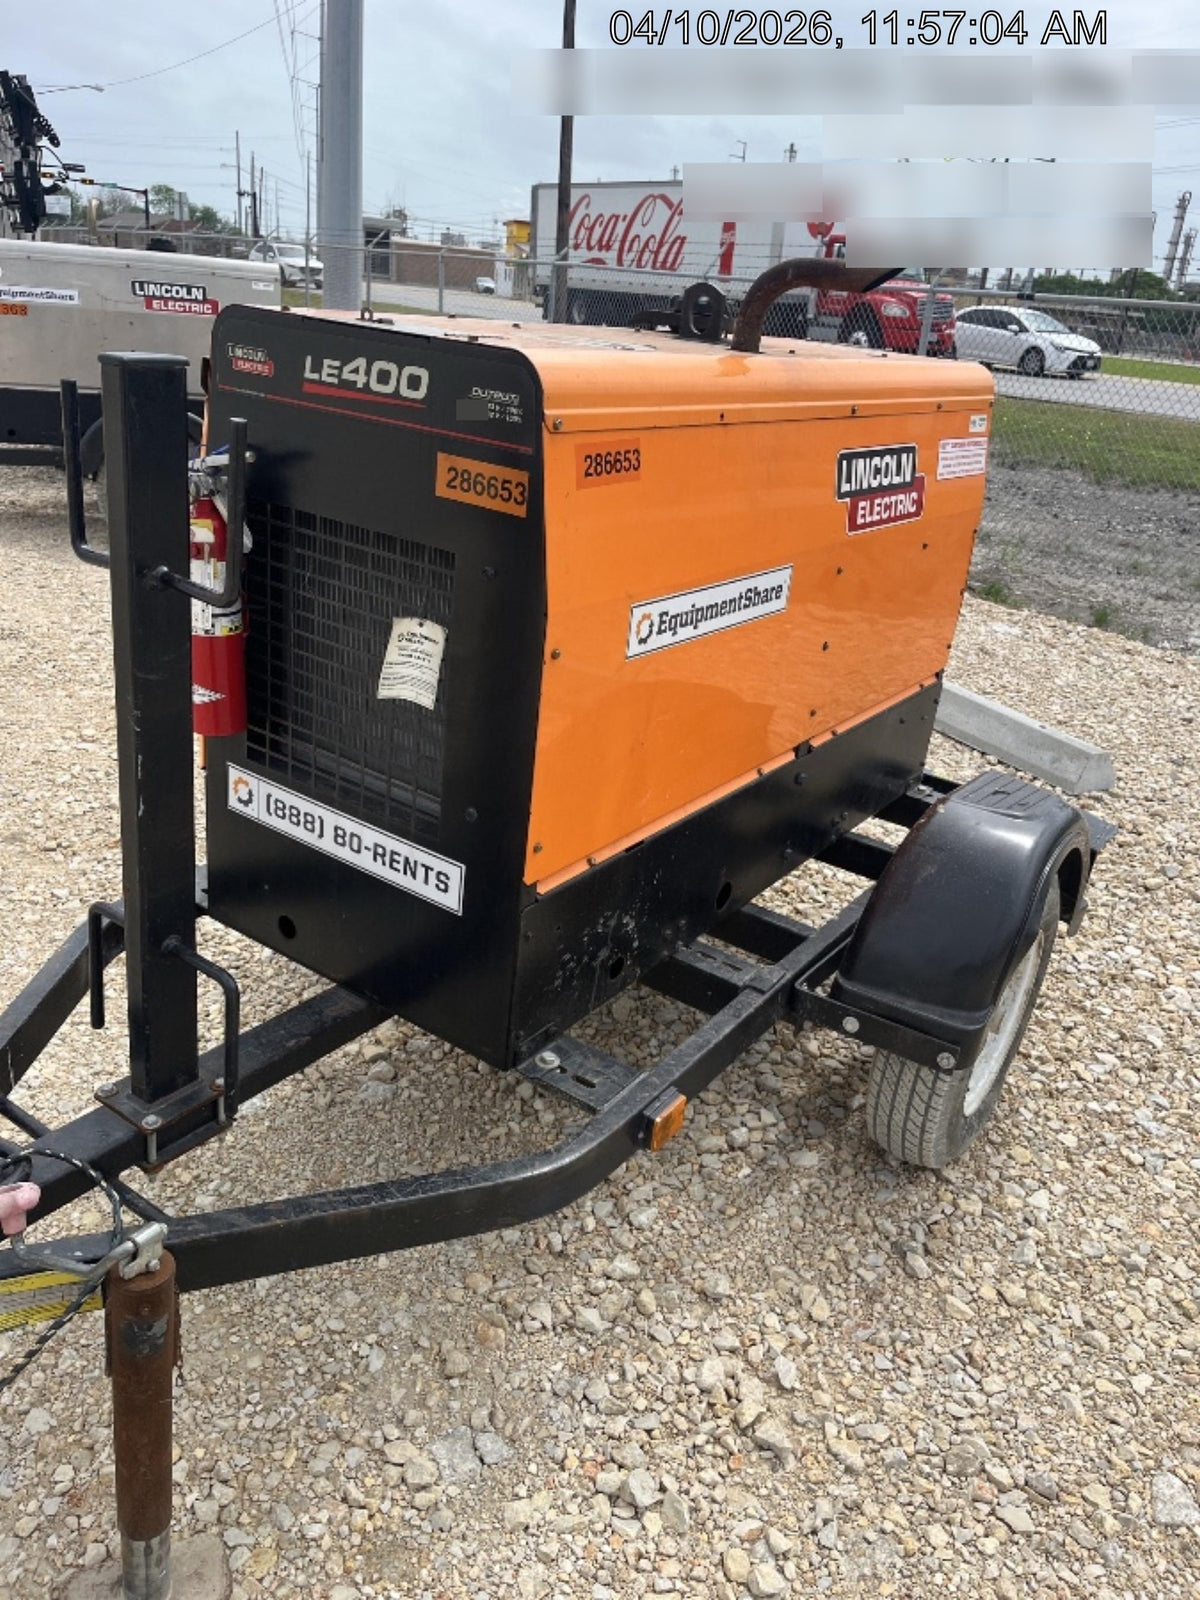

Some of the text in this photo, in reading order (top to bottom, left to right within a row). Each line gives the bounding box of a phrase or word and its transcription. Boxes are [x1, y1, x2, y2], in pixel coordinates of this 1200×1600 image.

[134, 282, 204, 300] LINCOLN
[152, 300, 213, 314] ELECTRIC
[303, 355, 429, 399] LE400
[584, 448, 641, 477] 286653
[841, 453, 913, 493] LINCOLN
[446, 466, 526, 506] 286653
[856, 491, 918, 525] ELECTRIC
[656, 584, 783, 637] EquipmentShare
[265, 792, 450, 893] (888) 80-RENTS
